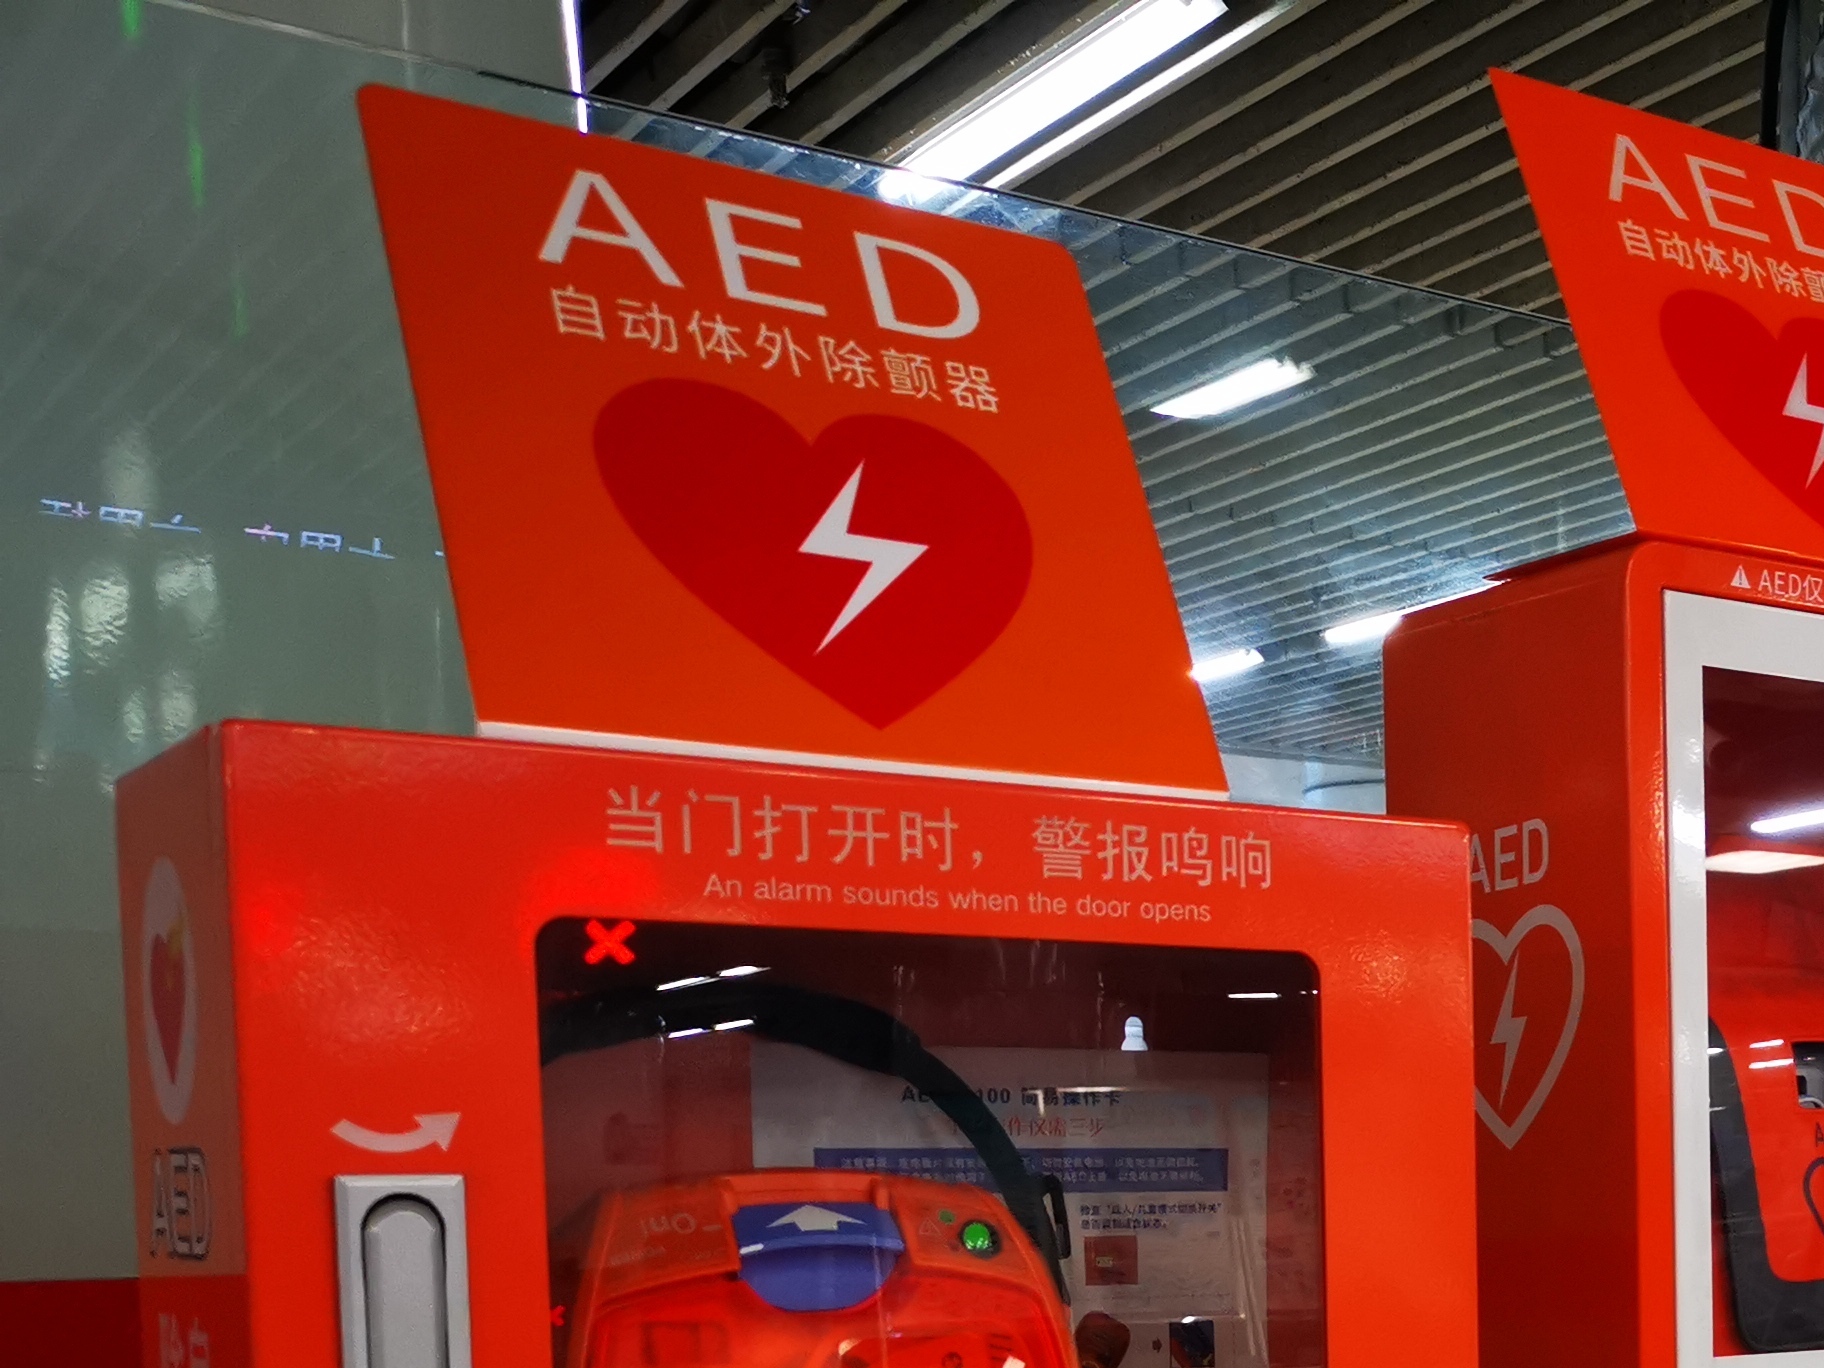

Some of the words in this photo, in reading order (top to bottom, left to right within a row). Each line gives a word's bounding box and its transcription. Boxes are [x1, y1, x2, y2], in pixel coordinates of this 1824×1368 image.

[538, 169, 981, 340] AED
[551, 284, 1000, 413] 自动体外除颤器
[703, 872, 743, 898] An
[753, 877, 832, 904] alarm
[842, 880, 939, 910] sounds
[948, 887, 1019, 913] when
[1027, 891, 1067, 916] the
[1076, 894, 1131, 919] door
[1140, 900, 1212, 923] opens
[1470, 818, 1549, 894] AED
